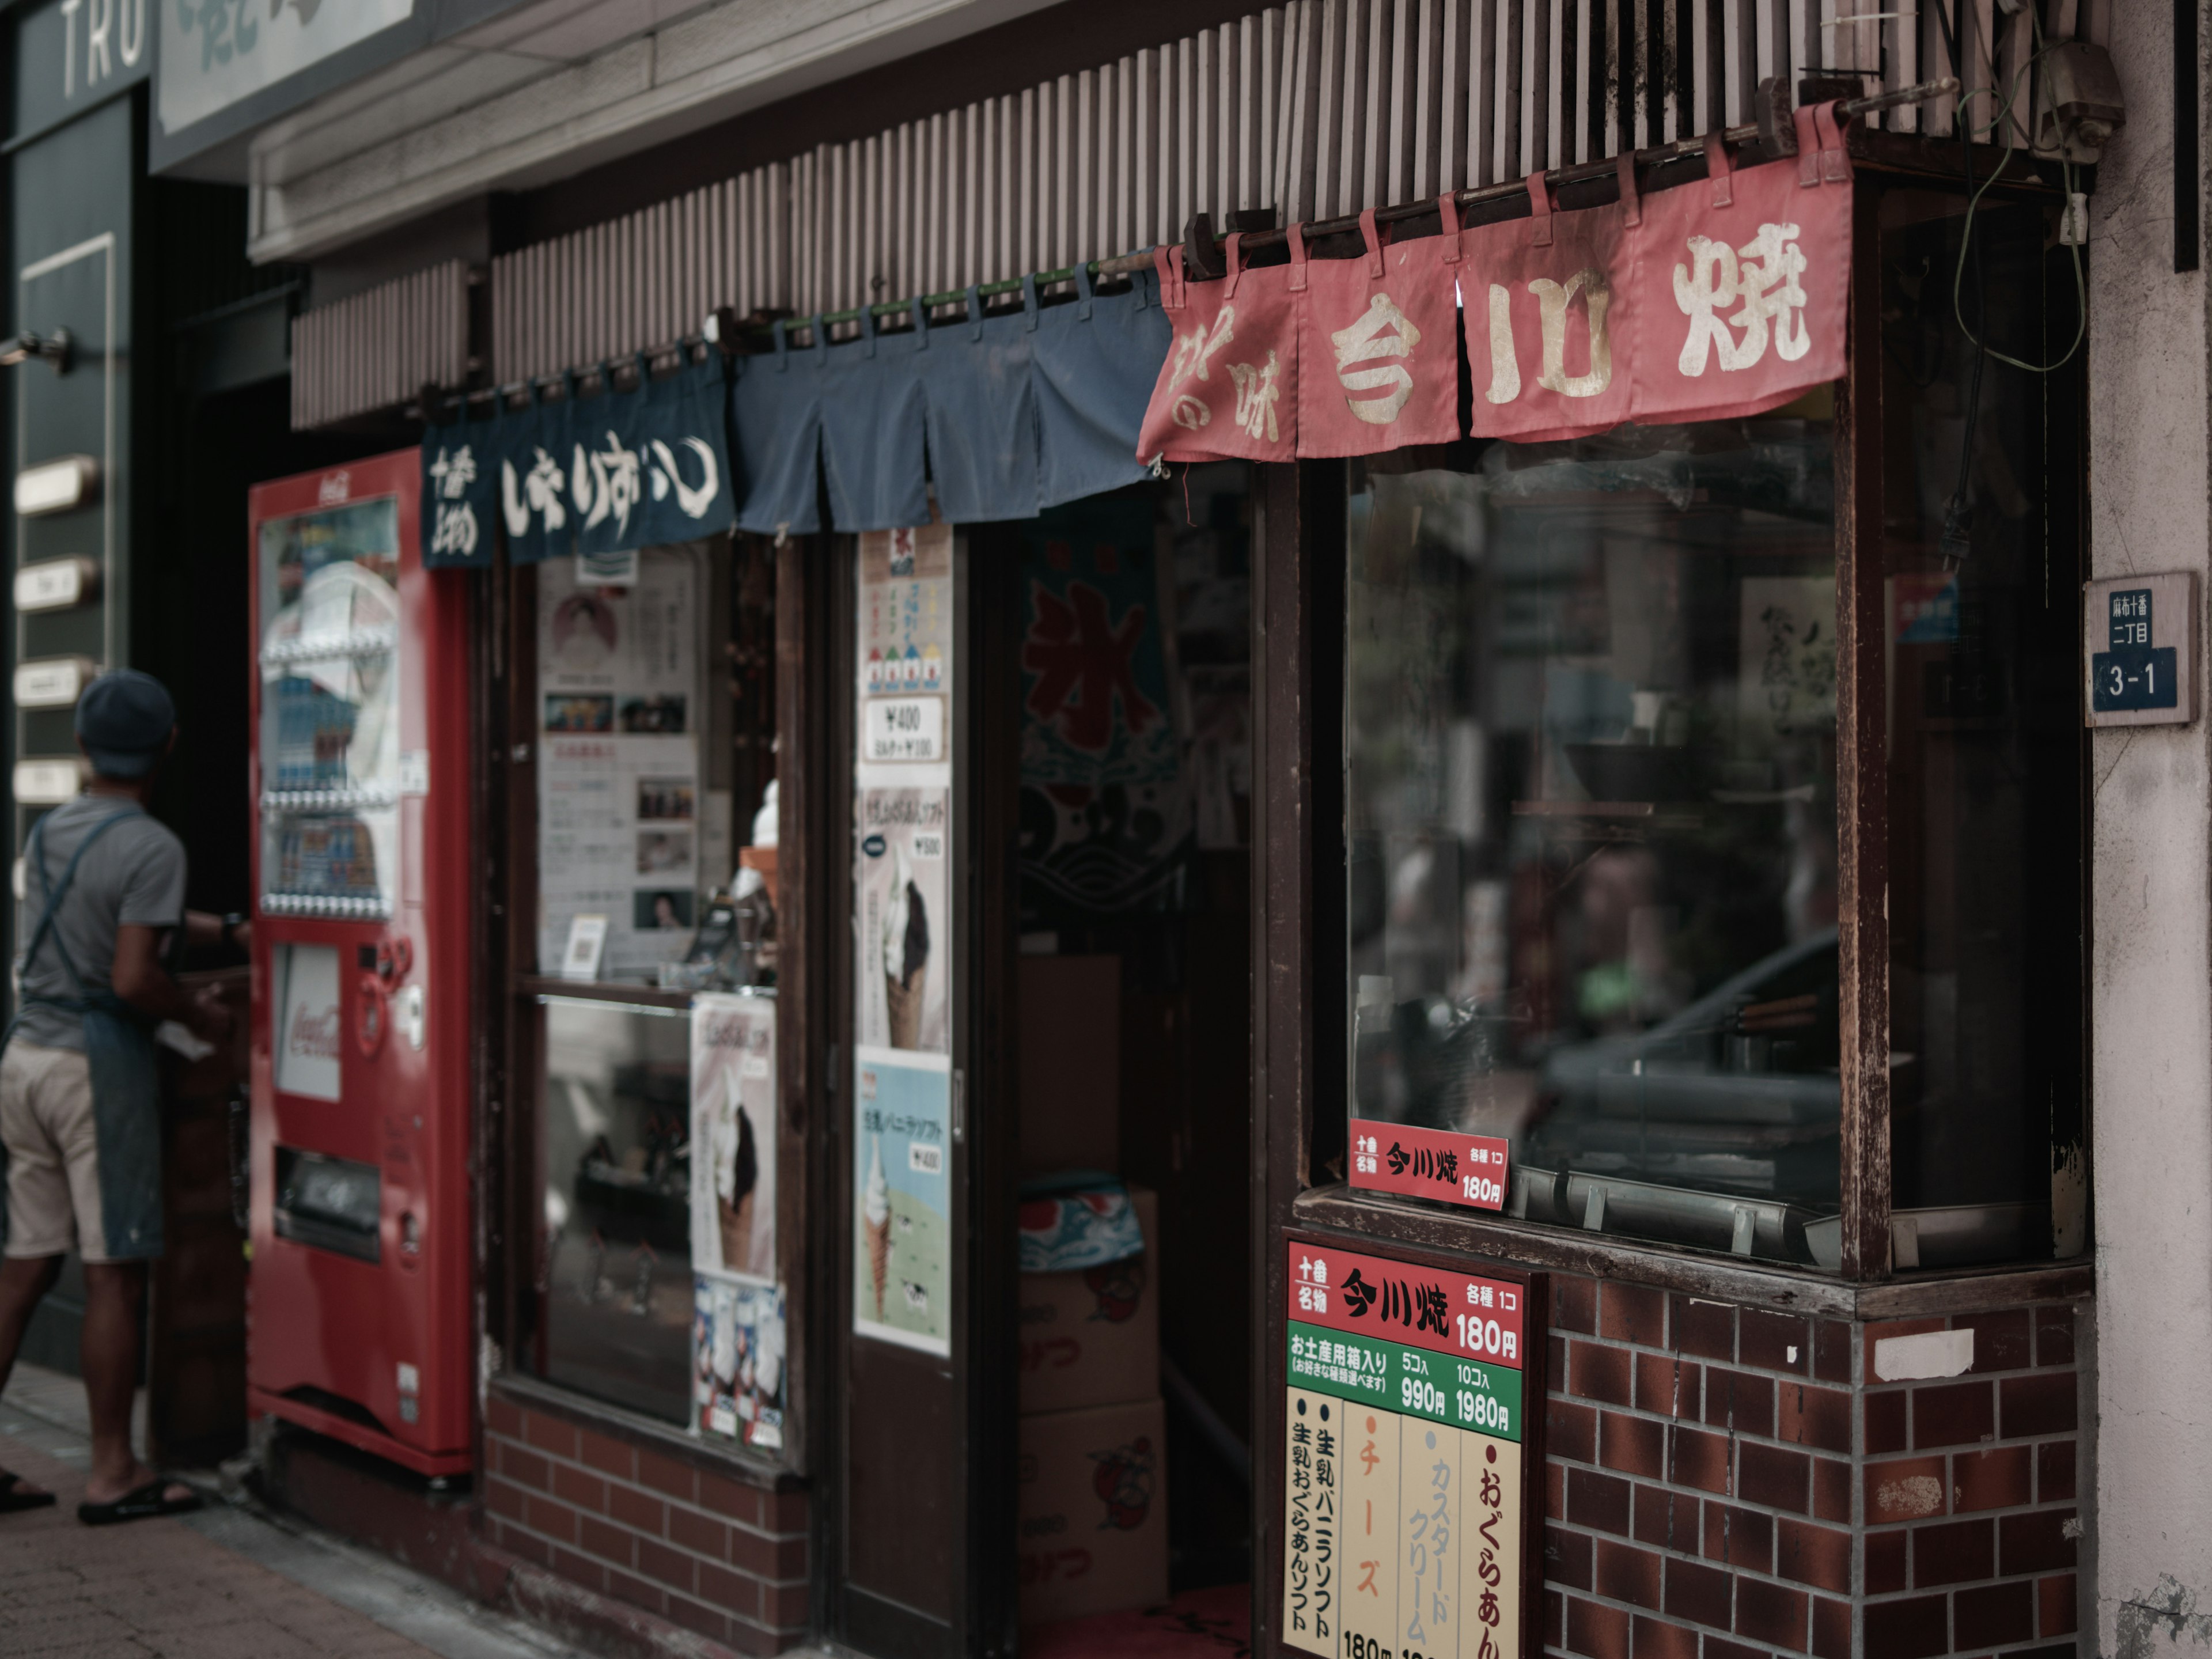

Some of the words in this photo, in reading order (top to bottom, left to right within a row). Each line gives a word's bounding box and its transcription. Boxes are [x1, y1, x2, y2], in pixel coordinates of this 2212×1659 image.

[1331, 222, 1810, 425] 今川焼
[2113, 594, 2147, 618] 麻布十番
[2113, 622, 2147, 644] 二丁目
[1024, 579, 1160, 751] 氷
[2109, 663, 2154, 695] 3-1
[1356, 1135, 1378, 1153] 十番
[1386, 1142, 1459, 1185] 今川焼
[1470, 1147, 1488, 1164] 各種
[1356, 1156, 1377, 1174] 名物
[1463, 1175, 1501, 1203] 180円
[1298, 1256, 1328, 1283] 十番
[1298, 1286, 1327, 1315] 名物
[1340, 1268, 1449, 1338] 今川焼
[1466, 1283, 1494, 1309] 各種
[1499, 1290, 1517, 1312] 1コ
[1291, 1334, 1387, 1374] お土産用箱入り
[1456, 1313, 1517, 1359] 180円
[1402, 1352, 1429, 1376] 5コ入
[1457, 1364, 1490, 1390] 10コ入
[1401, 1376, 1446, 1416] 990円
[1456, 1389, 1509, 1431] 1980円
[1315, 1429, 1335, 1639] 生乳バニラソフト
[1357, 1440, 1380, 1597] チーズ
[1430, 1458, 1450, 1625] カスタード
[1407, 1509, 1429, 1646] クリーム
[1477, 1468, 1502, 1659] おぐらあん
